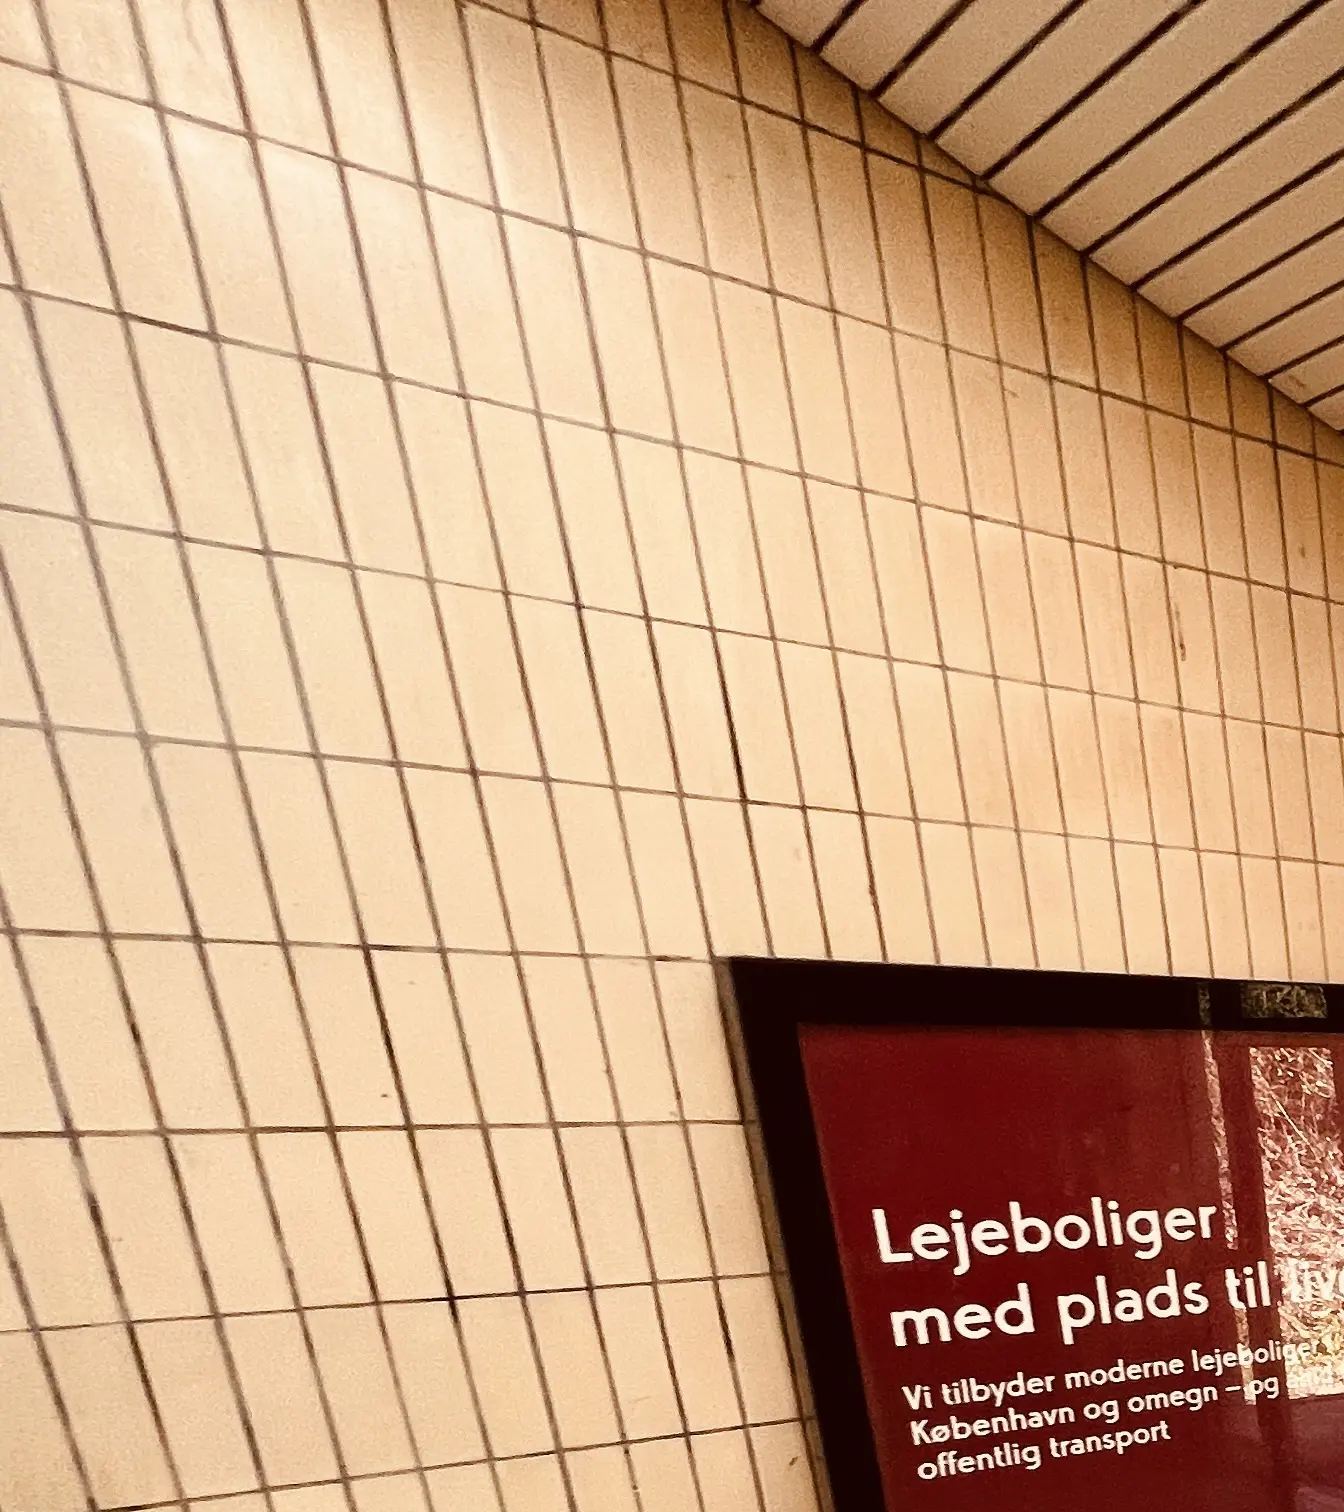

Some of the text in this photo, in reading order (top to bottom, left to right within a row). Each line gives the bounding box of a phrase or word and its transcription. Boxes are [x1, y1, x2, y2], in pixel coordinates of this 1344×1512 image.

[872, 1196, 1217, 1276] Lejeboliger
[890, 1282, 1036, 1347] med
[1057, 1268, 1210, 1345] plads
[1225, 1260, 1271, 1310] til
[901, 1339, 1319, 1411] Vi tilbyder moderne lejeboliger
[909, 1407, 1076, 1446] København
[1083, 1400, 1120, 1424] og
[1126, 1386, 1219, 1413] omegn
[1250, 1377, 1280, 1399] og
[917, 1420, 1172, 1480] offentlig transport
